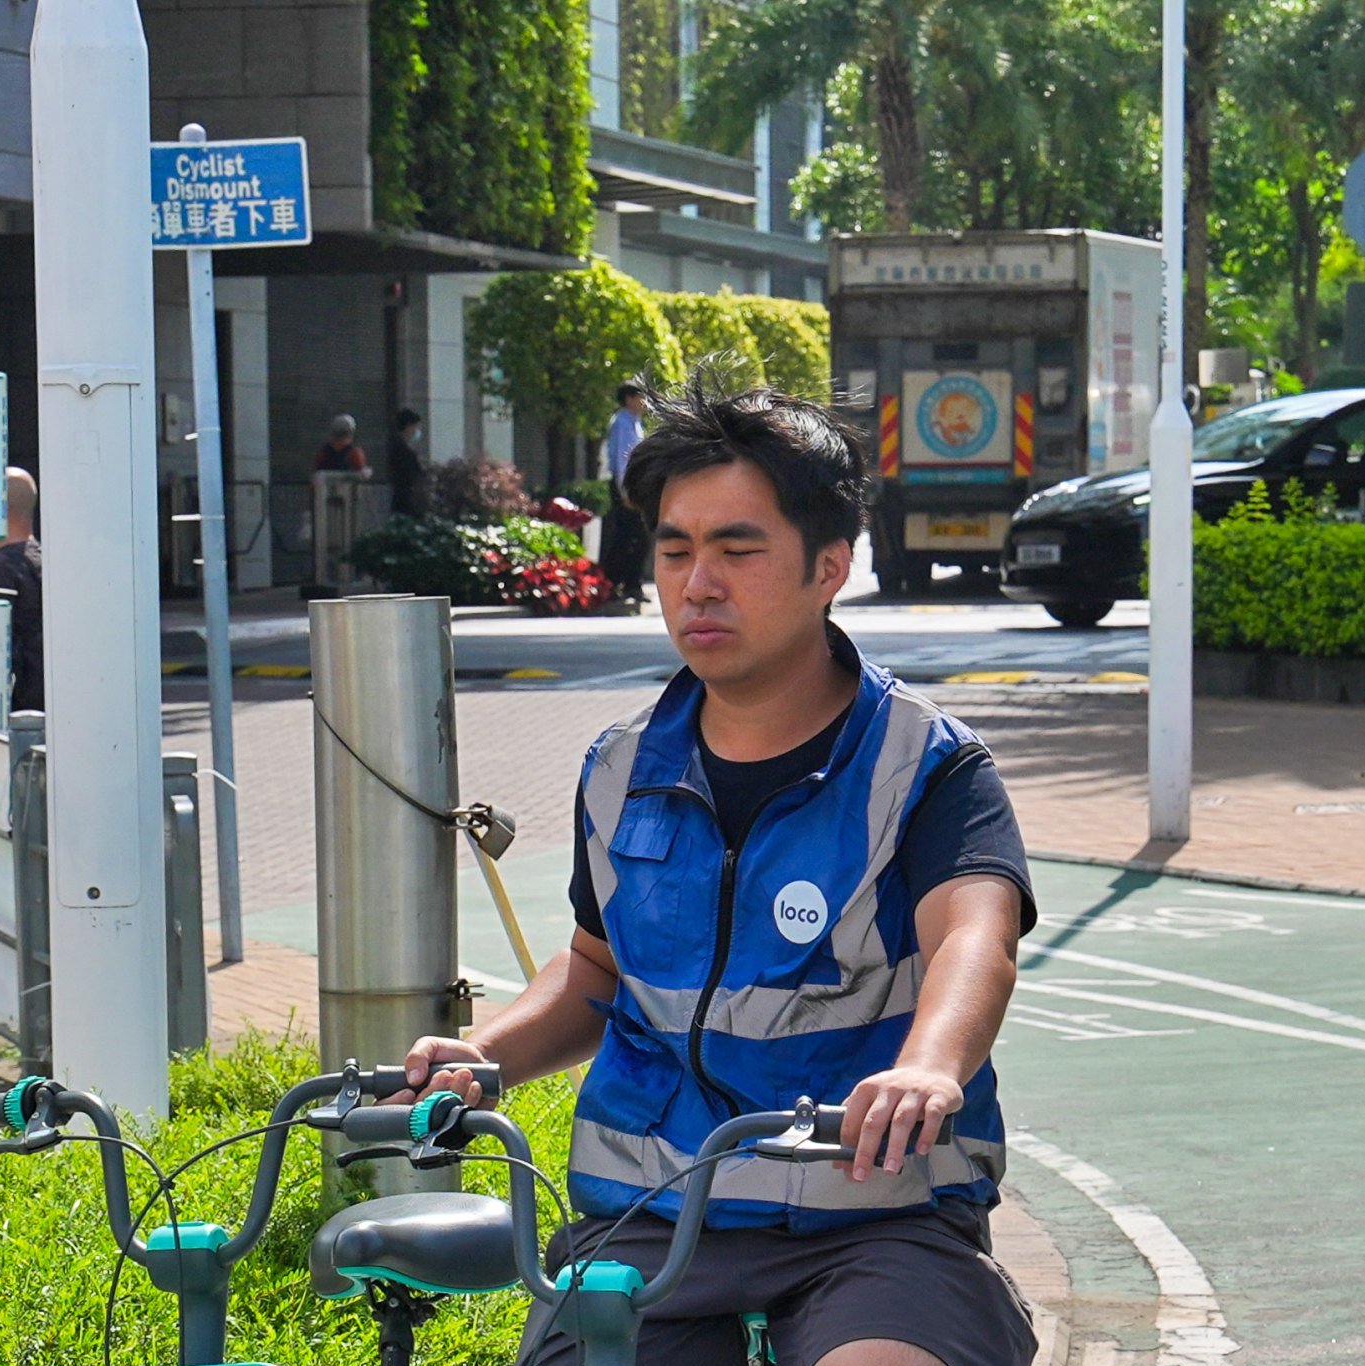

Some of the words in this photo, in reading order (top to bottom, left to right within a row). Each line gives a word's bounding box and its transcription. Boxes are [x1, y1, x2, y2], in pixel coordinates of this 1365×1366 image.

[176, 153, 245, 180] Cyclist
[167, 175, 261, 200] Dismount
[780, 900, 819, 924] loco
